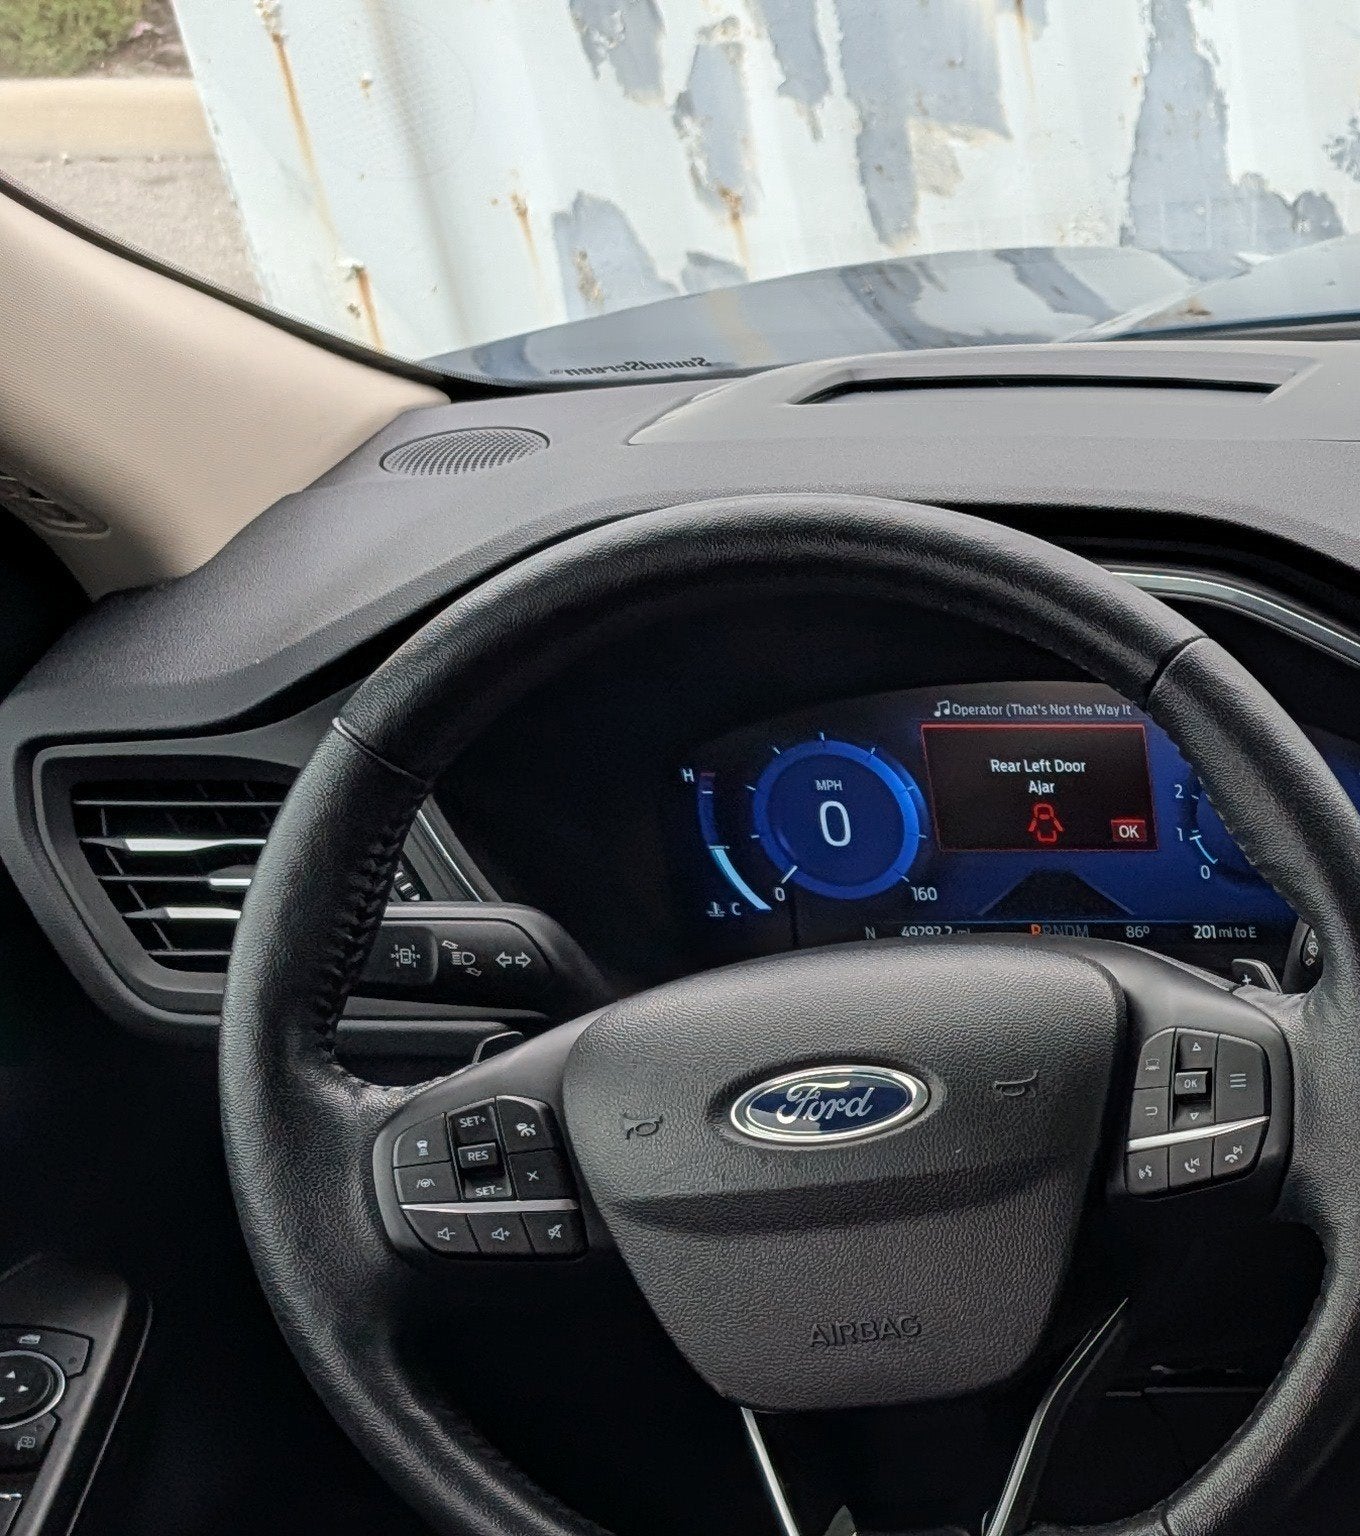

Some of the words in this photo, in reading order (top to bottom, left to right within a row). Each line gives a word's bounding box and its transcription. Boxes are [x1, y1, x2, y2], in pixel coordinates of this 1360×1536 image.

[952, 704, 1003, 717] Operator
[1006, 703, 1048, 717] (That's
[1050, 704, 1072, 716] Not
[1074, 704, 1093, 716] the
[1094, 704, 1120, 717] Way
[1122, 704, 1132, 716] It
[990, 759, 1021, 773] Rear
[1023, 759, 1052, 773] Left
[1054, 759, 1086, 773] Door
[682, 767, 694, 783] H
[815, 780, 843, 792] MPH
[1028, 780, 1055, 795] Ajar
[1174, 784, 1184, 799] 2
[819, 800, 852, 847] 0
[1118, 825, 1139, 838] OK
[1176, 827, 1184, 842] 1
[1200, 865, 1211, 880] 0
[774, 887, 786, 902] 0
[910, 886, 938, 902] 160
[731, 902, 742, 916] C
[865, 926, 876, 939] N
[1193, 925, 1216, 940] 201
[1218, 926, 1233, 938] mi
[1234, 926, 1247, 938] to
[1249, 926, 1257, 938] E
[1184, 1079, 1198, 1089] OK
[776, 1081, 876, 1125] Ford
[459, 1115, 486, 1128] SET+
[467, 1150, 489, 1162] RES
[810, 1315, 921, 1347] AIRBAG
